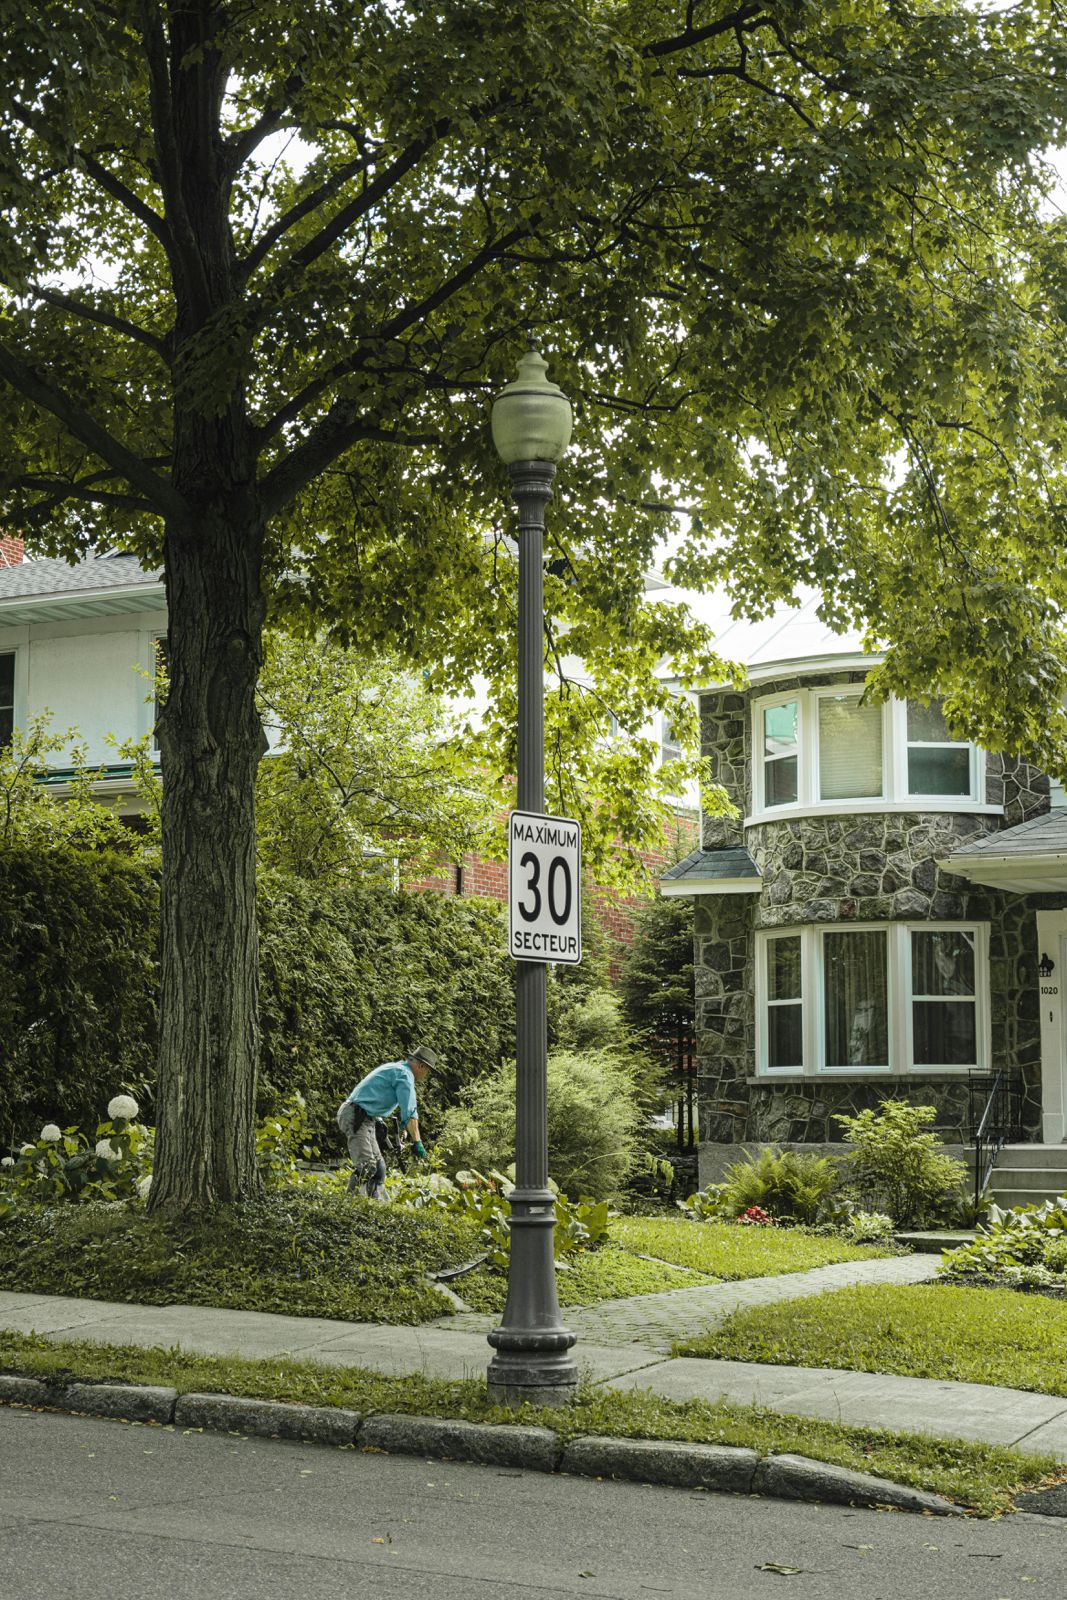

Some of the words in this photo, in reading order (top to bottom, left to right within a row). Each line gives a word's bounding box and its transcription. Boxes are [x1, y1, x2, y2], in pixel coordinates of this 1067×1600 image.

[513, 823, 577, 848] MAXIMUM
[518, 851, 572, 926] 30
[514, 931, 577, 954] SECTEUR
[1041, 986, 1058, 995] 1020
